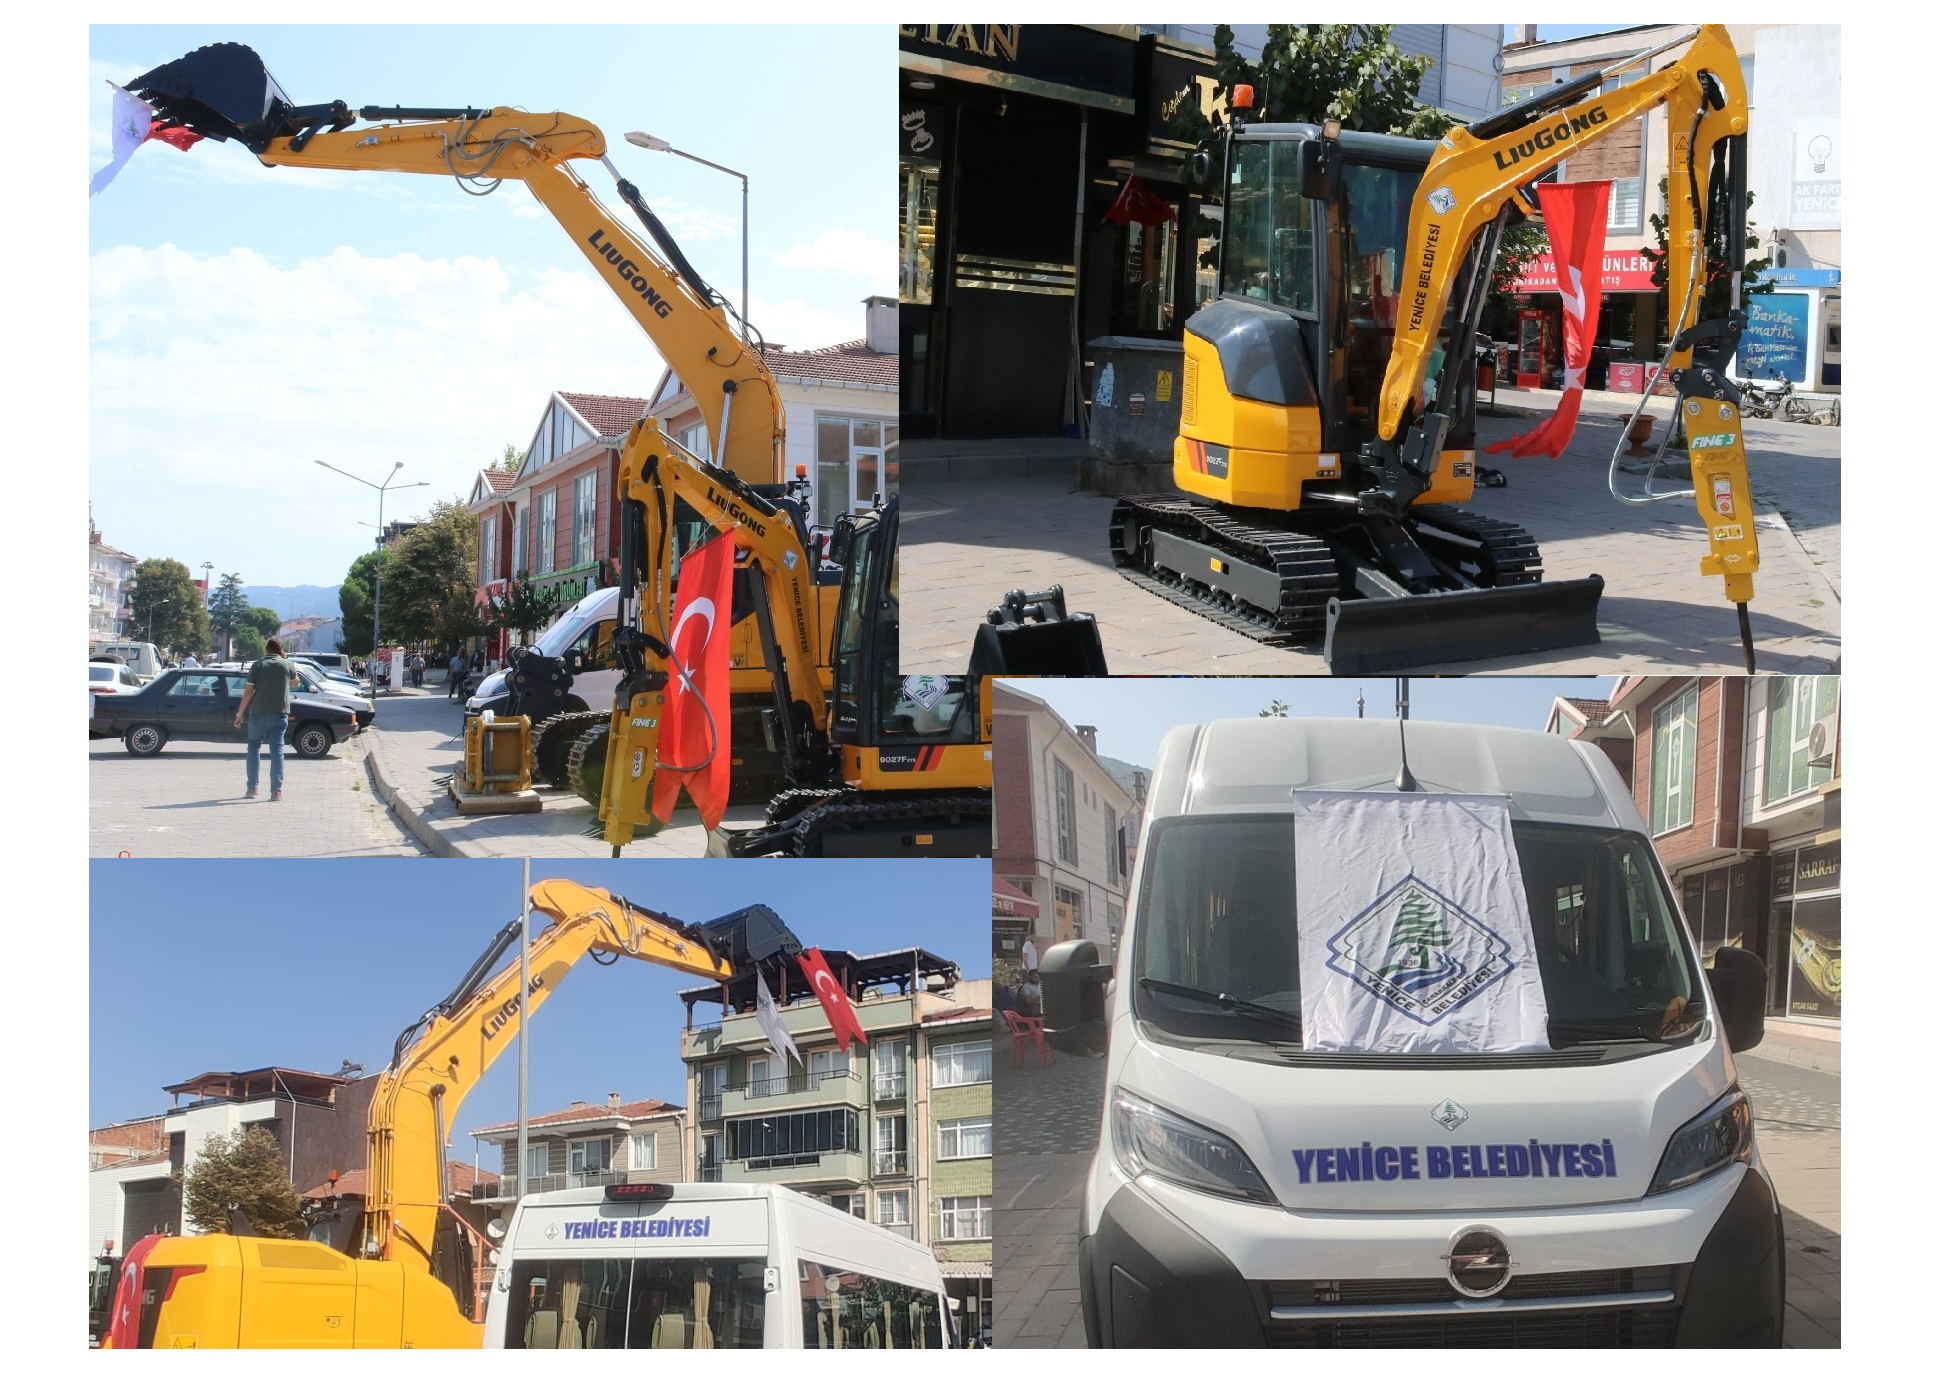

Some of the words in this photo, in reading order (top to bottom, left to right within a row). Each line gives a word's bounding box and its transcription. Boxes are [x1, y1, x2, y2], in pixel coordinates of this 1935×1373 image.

[1794, 184, 1811, 196] AK
[1409, 291, 1427, 332] YENİCE
[1418, 223, 1441, 289] BELEDİYESİ
[1601, 276, 1621, 287] ATIŞ
[1691, 435, 1725, 449] FINE
[1725, 433, 1736, 445] 3
[631, 718, 651, 727] FINE
[1293, 1141, 1420, 1184] YENİCE
[1426, 1138, 1617, 1179] BELEDİYESİ
[564, 1218, 617, 1240] YENİCE
[620, 1215, 711, 1238] BELEDİYESİ
